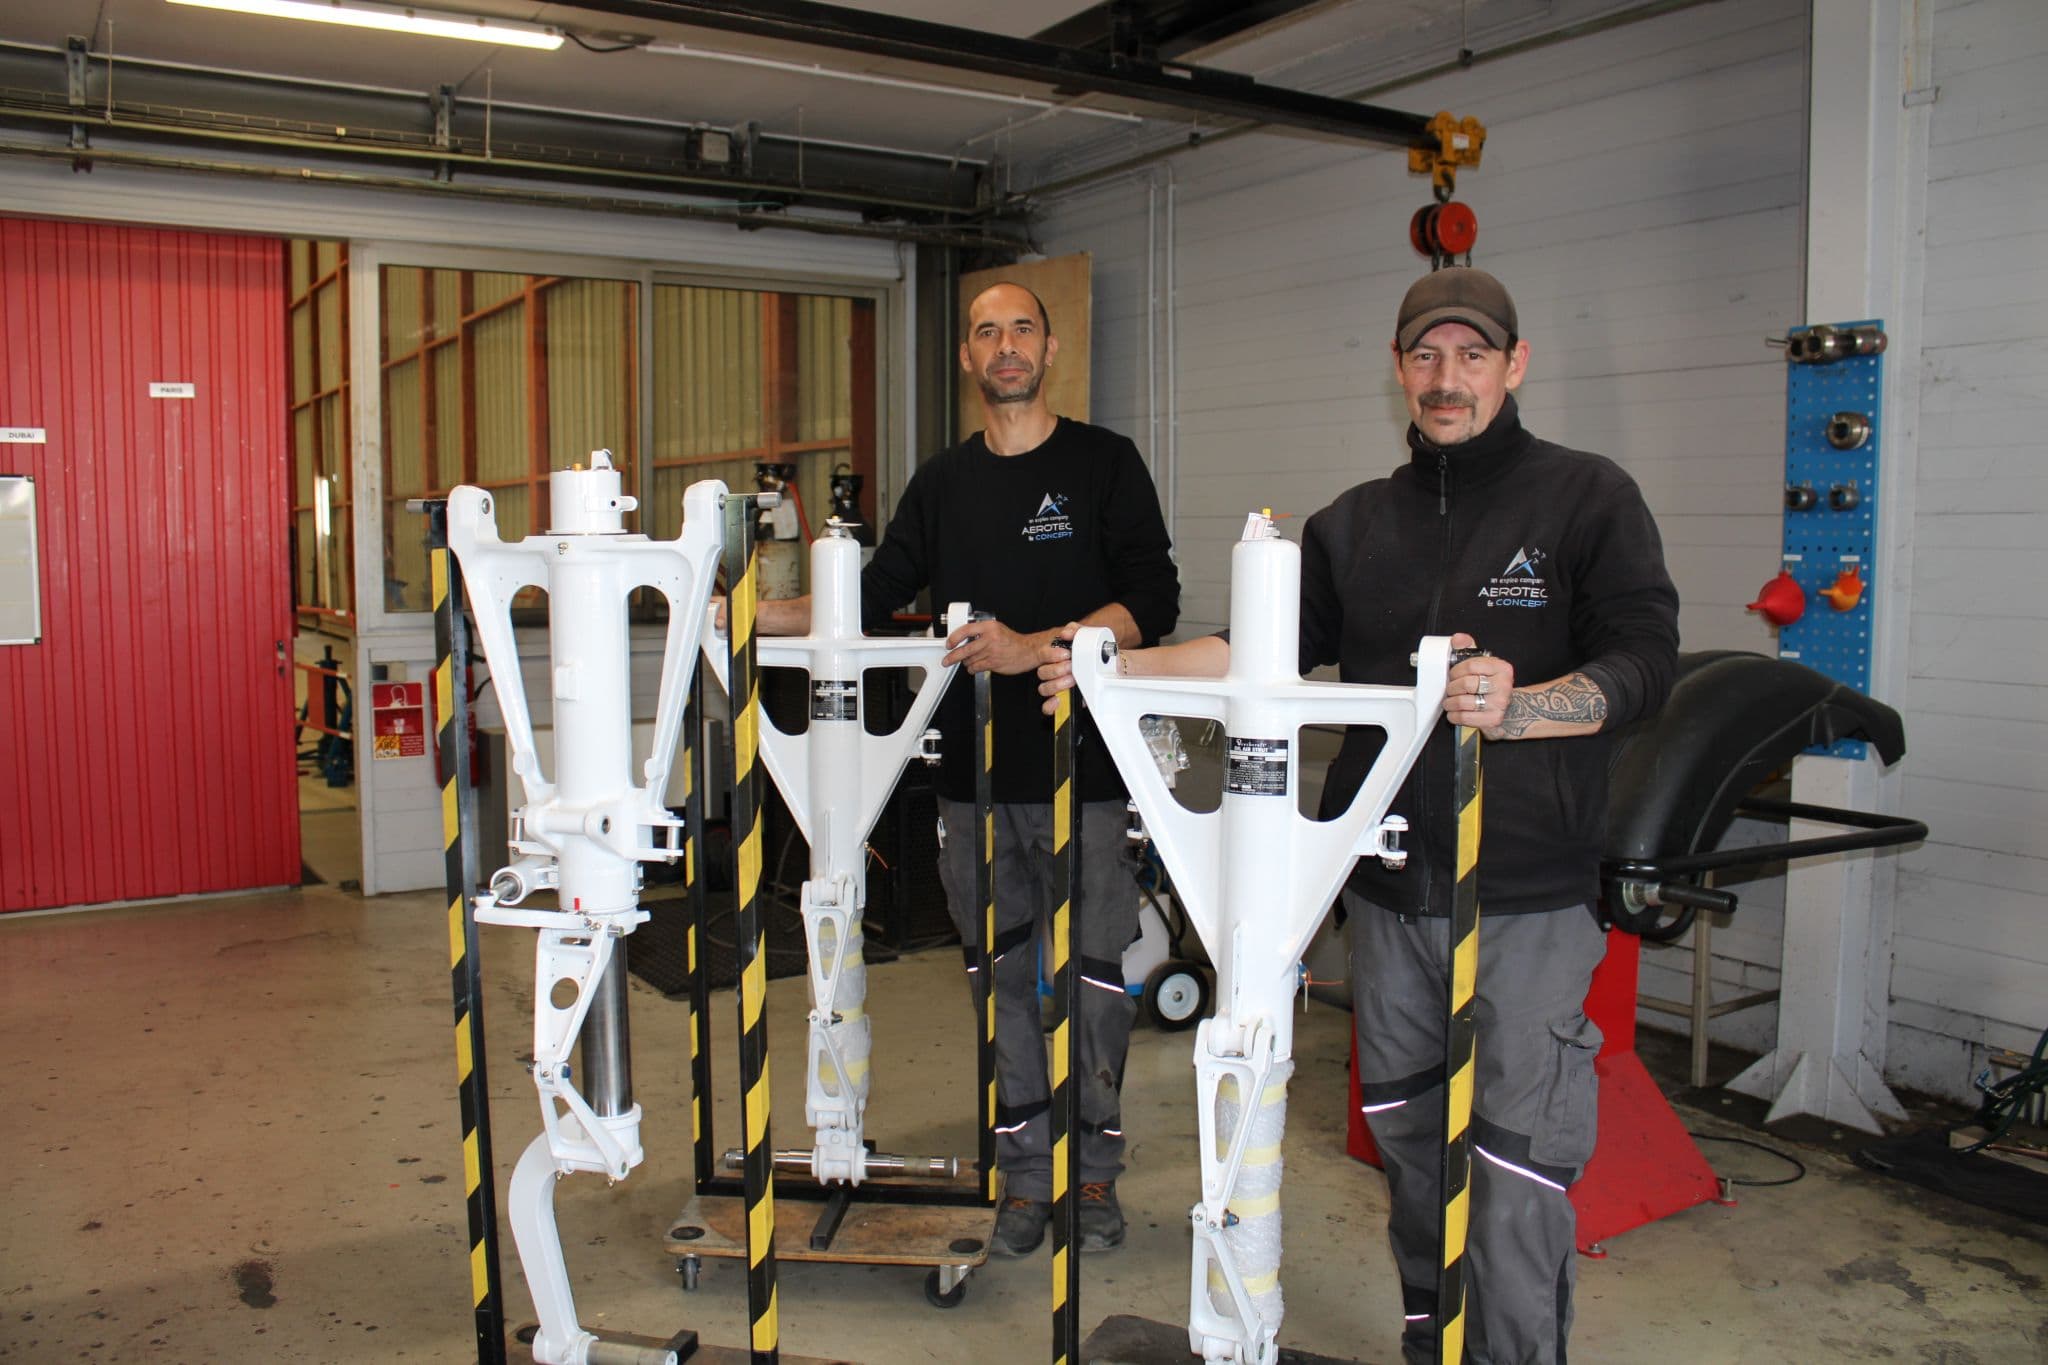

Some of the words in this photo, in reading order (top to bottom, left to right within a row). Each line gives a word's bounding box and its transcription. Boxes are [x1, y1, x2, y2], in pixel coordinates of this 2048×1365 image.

[1021, 522, 1073, 535] AEROTEC
[1035, 531, 1073, 541] CONCEPT
[1478, 586, 1549, 598] AEROTEC
[1495, 598, 1548, 608] CONCEPT
